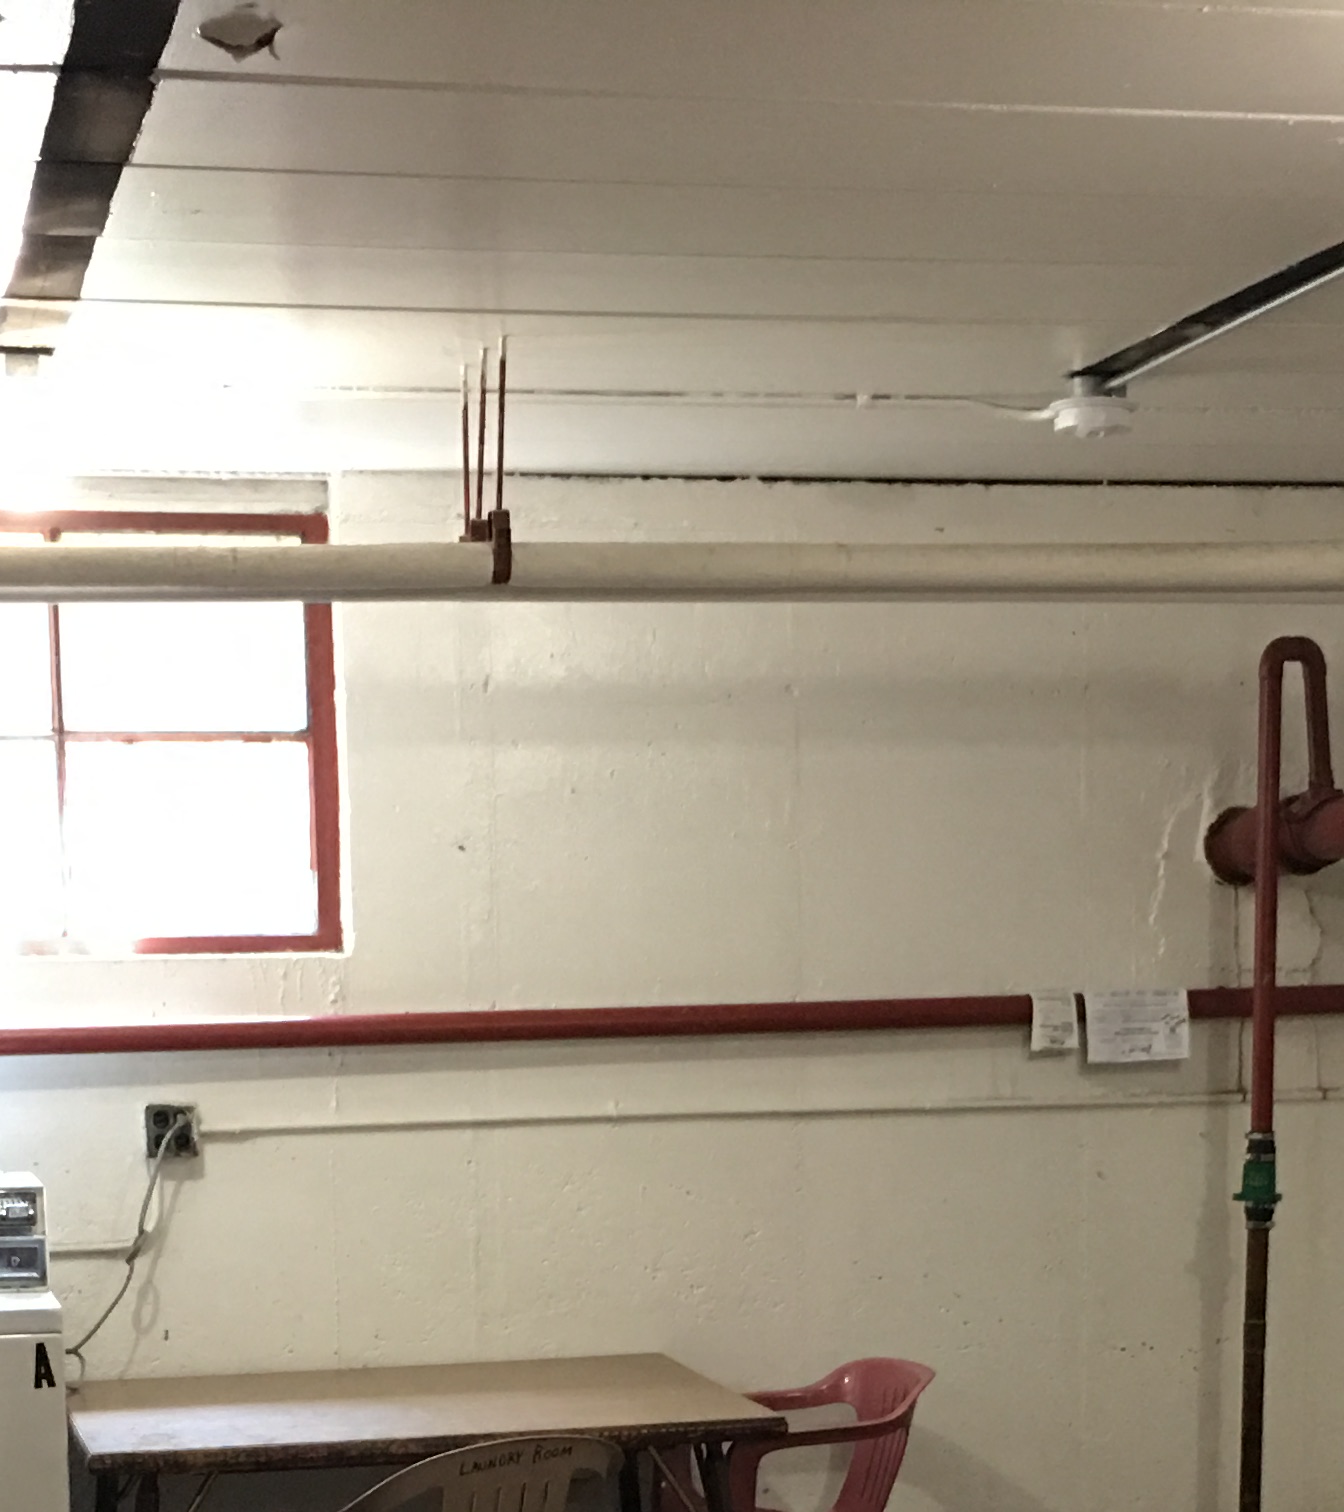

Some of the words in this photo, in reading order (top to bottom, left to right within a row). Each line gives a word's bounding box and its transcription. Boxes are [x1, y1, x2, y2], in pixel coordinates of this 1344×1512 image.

[34, 1342, 57, 1389] A
[459, 1451, 523, 1476] LAUNDRY
[532, 1444, 573, 1464] ROOM
